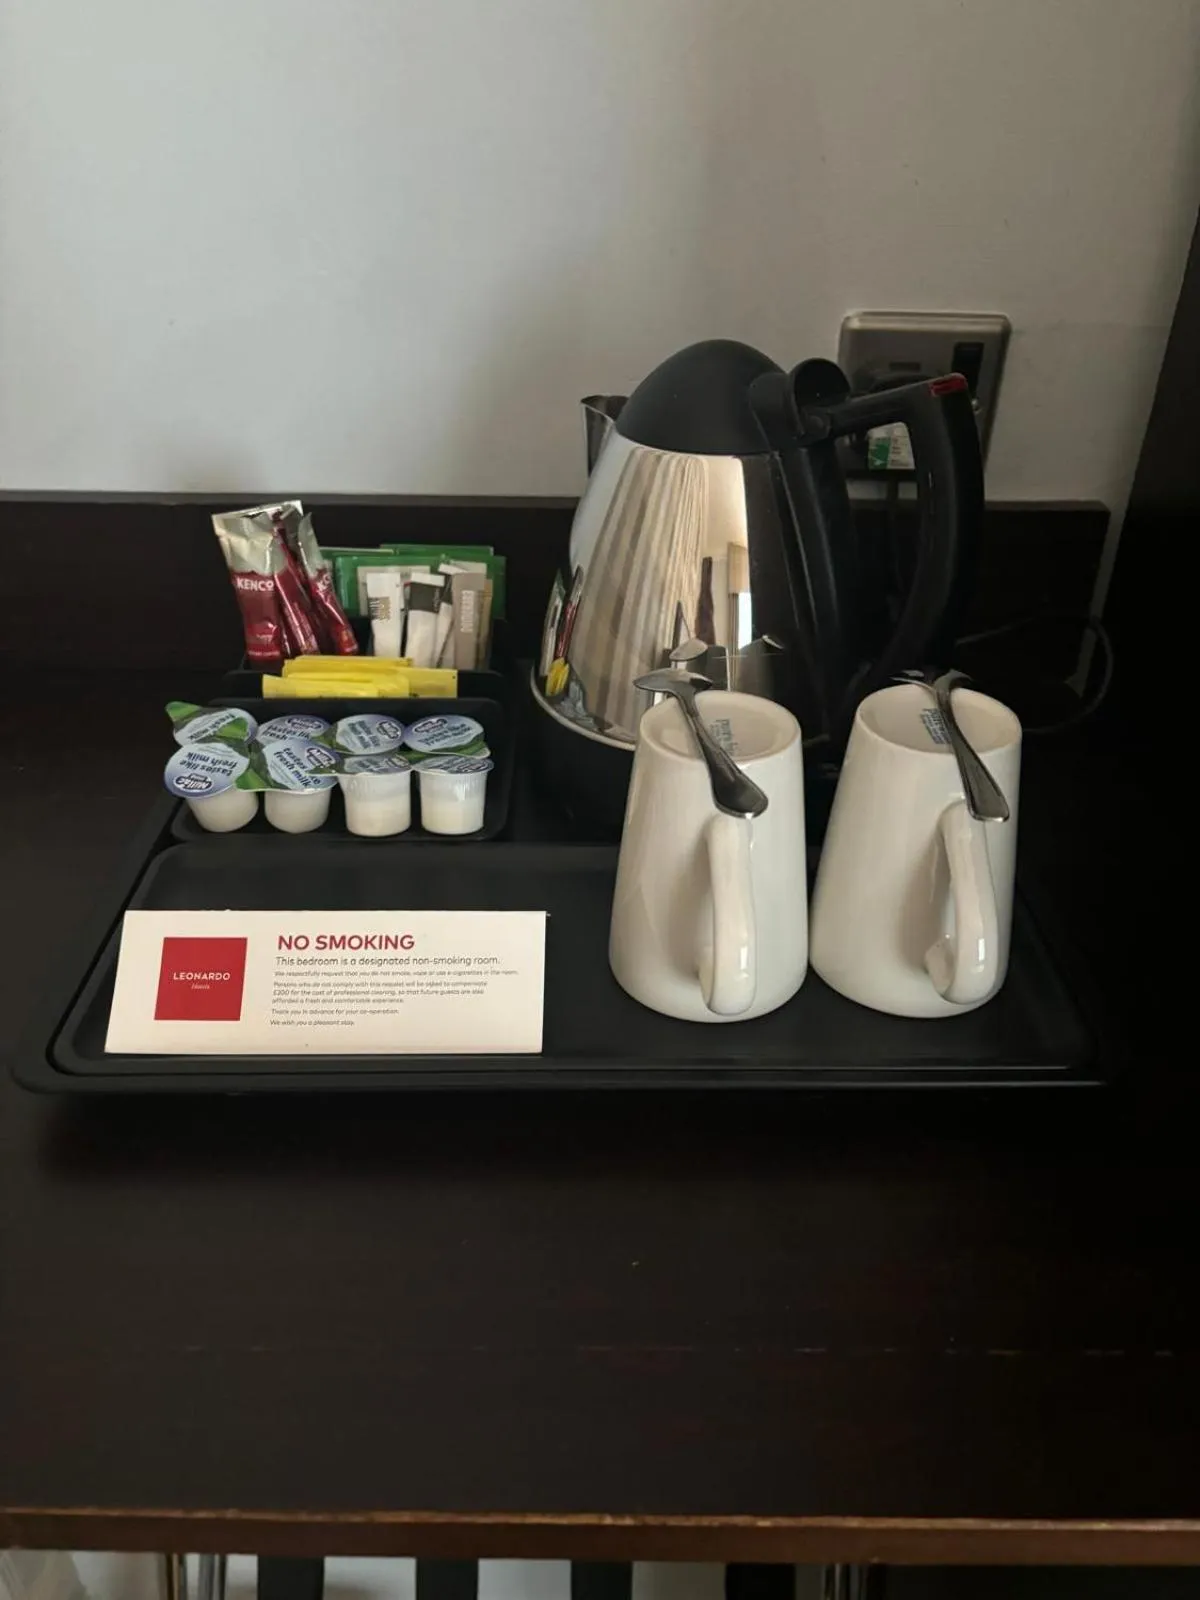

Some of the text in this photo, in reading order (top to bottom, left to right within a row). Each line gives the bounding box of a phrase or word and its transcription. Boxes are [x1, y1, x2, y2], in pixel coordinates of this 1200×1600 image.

[235, 577, 274, 591] KENCO
[179, 760, 200, 771] like
[186, 752, 238, 769] fresh milk
[199, 765, 233, 777] tastes
[273, 750, 295, 771] fresh
[291, 770, 313, 787] milk
[278, 934, 415, 950] NO SMOKING
[276, 956, 295, 966] This
[296, 956, 338, 966] bedroom
[340, 956, 348, 966] is
[358, 956, 410, 966] designated
[412, 956, 472, 966] non-smoking
[473, 956, 500, 966] room.
[173, 971, 231, 981] LEONARDO
